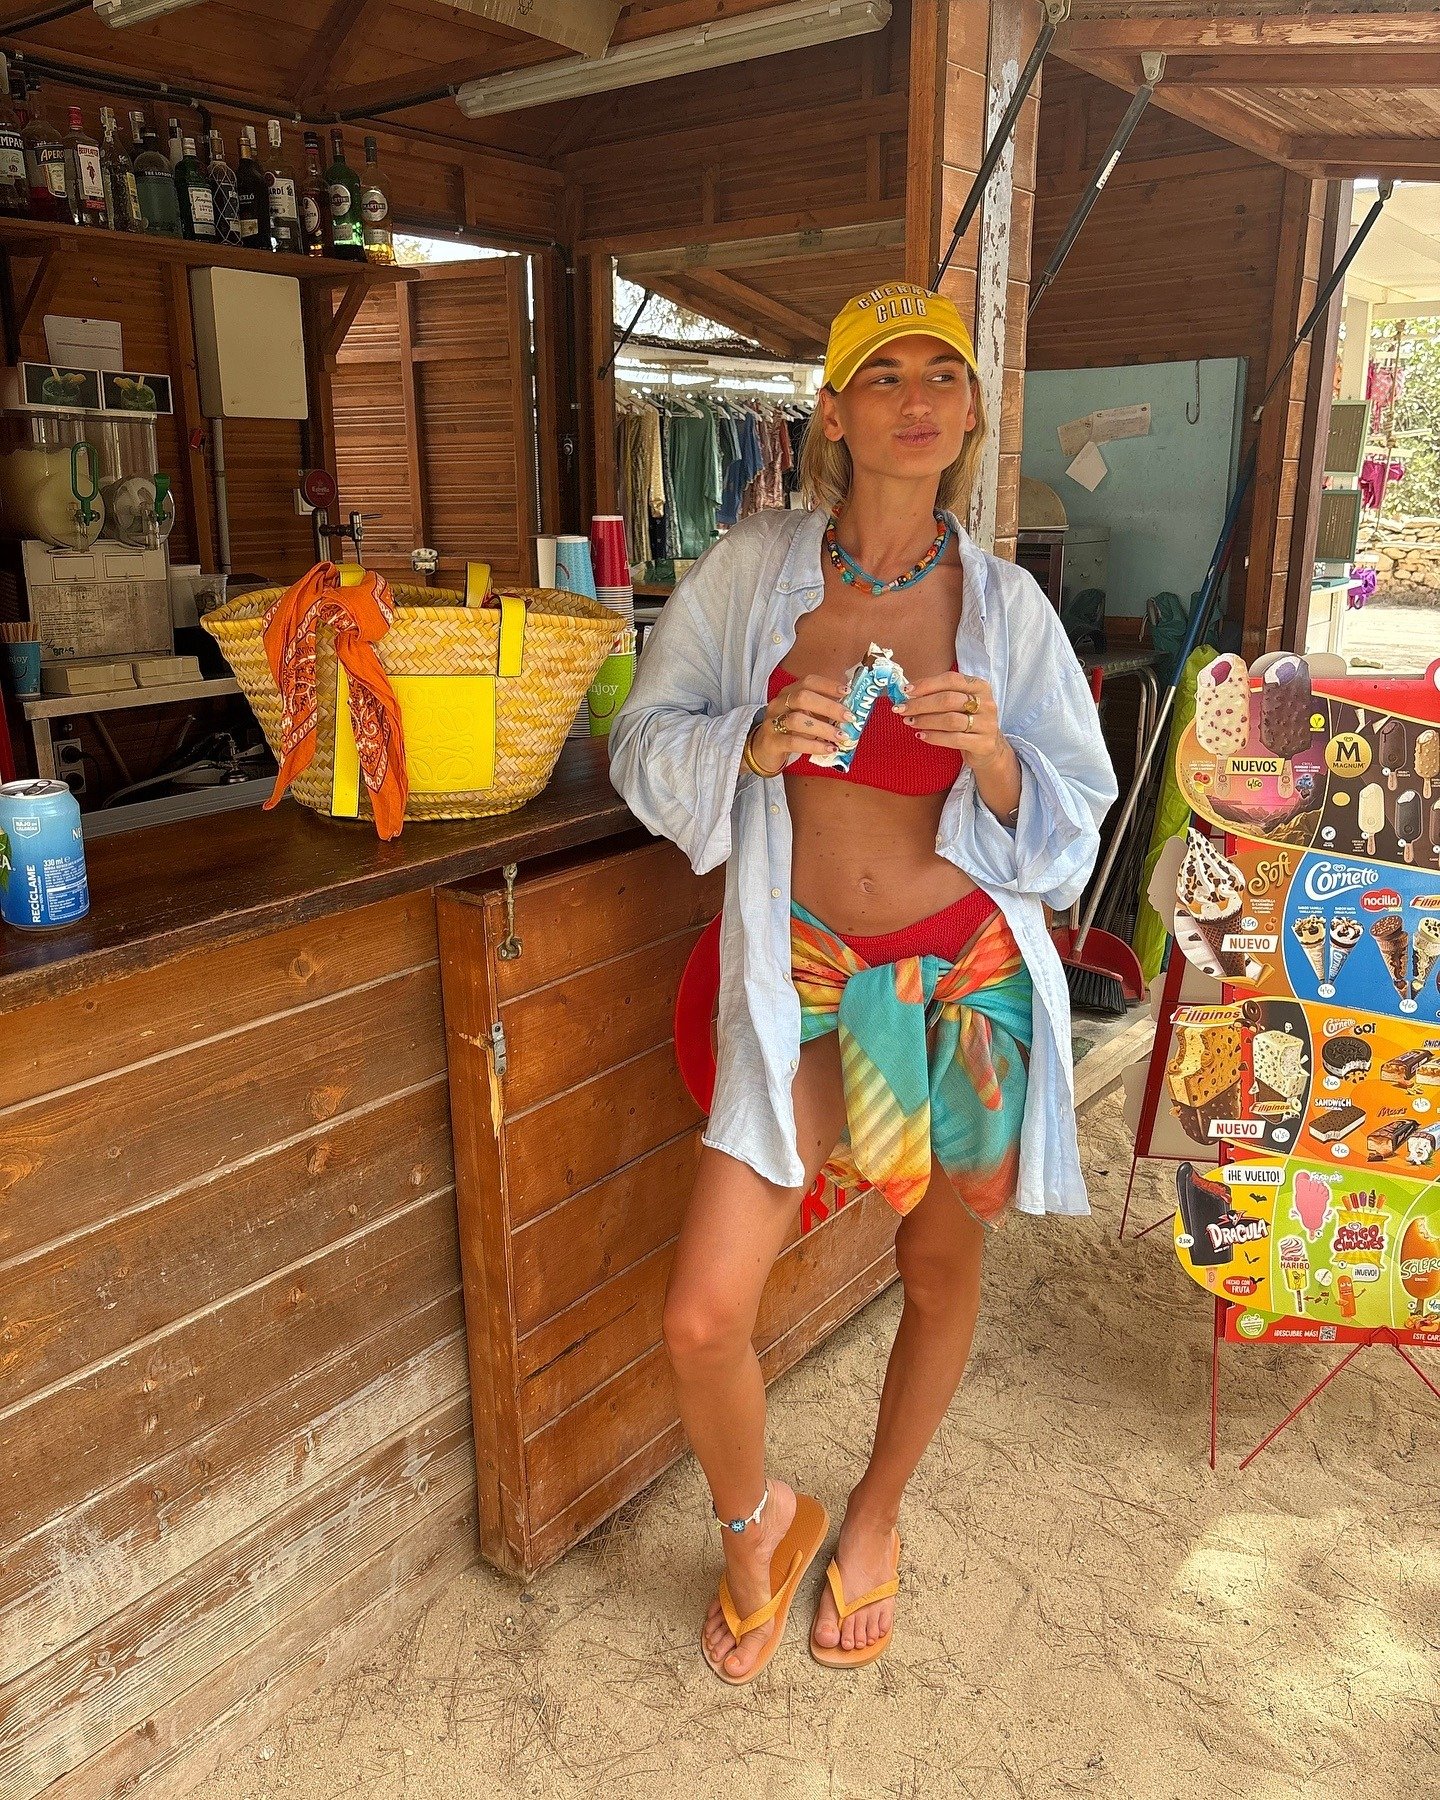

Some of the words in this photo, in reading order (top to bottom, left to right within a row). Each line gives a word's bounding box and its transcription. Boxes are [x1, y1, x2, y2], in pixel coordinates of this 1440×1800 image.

[858, 285, 936, 310] CHERRY
[876, 297, 928, 324] CLUB
[1336, 740, 1361, 763] M
[1231, 760, 1278, 773] NUEVOS
[1332, 762, 1365, 770] MAGNUM
[43, 858, 55, 868] 330
[1248, 851, 1293, 896] Soft
[1304, 861, 1379, 901] Cornetto
[26, 864, 41, 923] RECÍCLAME
[1363, 894, 1398, 906] nocilla
[1229, 938, 1270, 950] NUEVO
[1173, 1007, 1240, 1023] Filipinos
[1323, 1018, 1355, 1038] Cornetto
[1354, 1022, 1377, 1035] GO!
[1251, 1102, 1290, 1112] Filipinos
[1314, 1098, 1352, 1107] SANDWICH
[1216, 1123, 1258, 1135] NUEVO
[1228, 1170, 1242, 1182] ¡HE
[1244, 1170, 1280, 1183] VUELTO!
[1206, 1219, 1269, 1249] DRACULA
[1338, 1224, 1379, 1241] FRIGO
[1333, 1236, 1385, 1252] CHUCHES
[1280, 1261, 1310, 1270] HARIBO
[1231, 1285, 1251, 1294] FRUTA
[1304, 1329, 1319, 1338] MÁS!
[1412, 1332, 1426, 1341] ESTE
